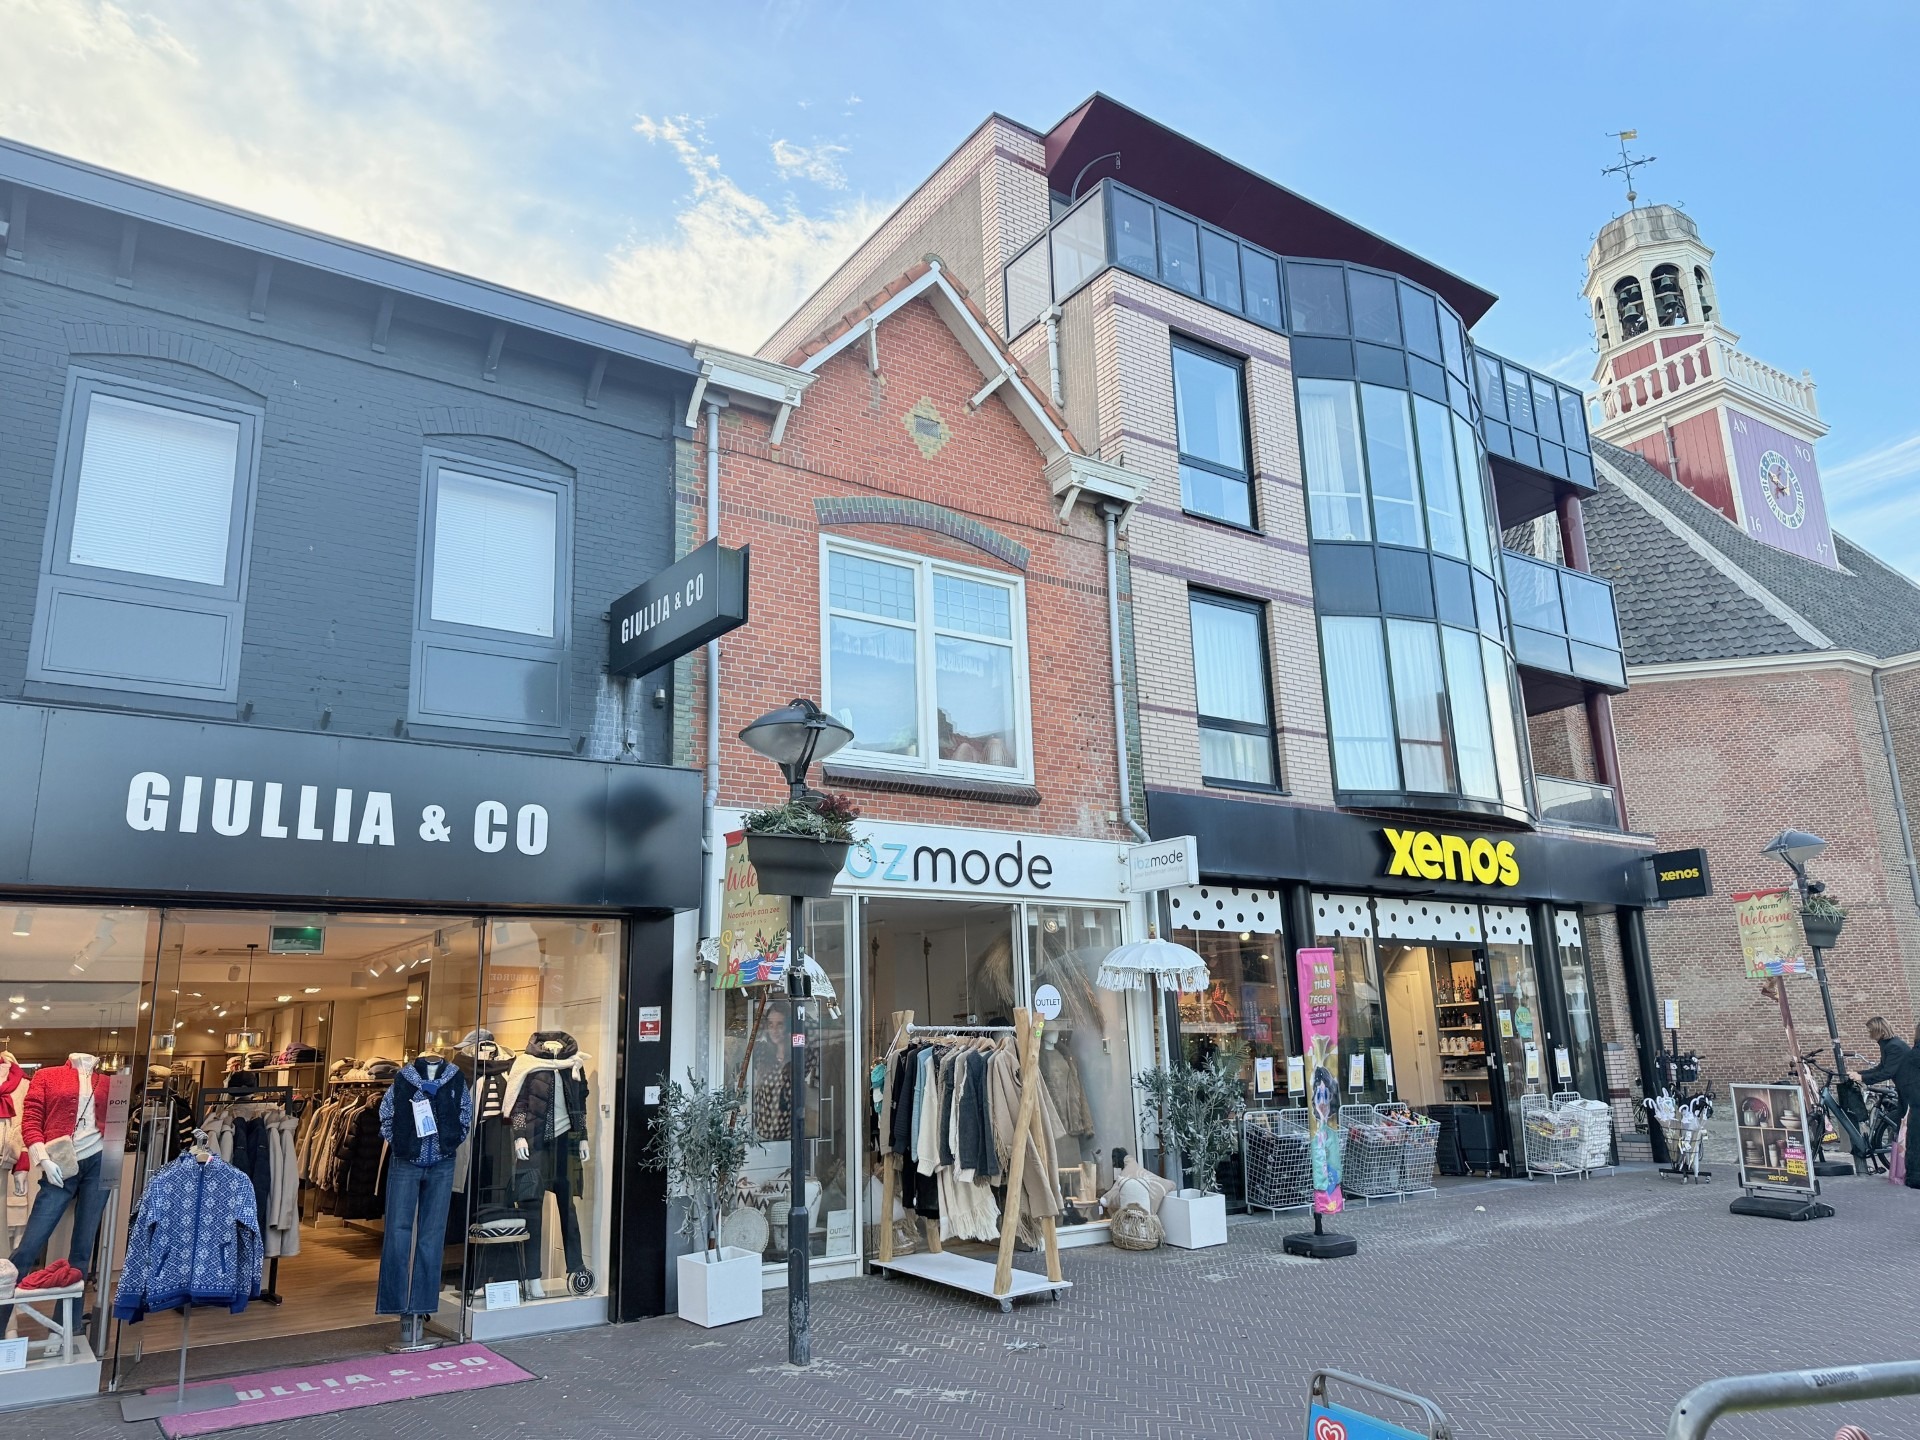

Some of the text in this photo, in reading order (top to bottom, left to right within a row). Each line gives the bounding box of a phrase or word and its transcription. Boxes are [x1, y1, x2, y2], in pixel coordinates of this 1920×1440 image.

[1750, 515, 1762, 533] 16
[621, 572, 704, 644] GIULLIA & CO
[126, 771, 549, 856] GIULLIA & CO
[739, 854, 745, 863] A
[1134, 850, 1183, 870] ibzmode
[1383, 827, 1520, 887] xenos
[727, 864, 757, 892] Welc
[1660, 866, 1699, 881] xenos
[727, 909, 757, 919] Noordwijk
[1740, 911, 1793, 926] Welcome
[235, 1374, 375, 1401] ULLIA
[427, 1356, 488, 1371] CO
[331, 1365, 499, 1394] DAMESMODE
